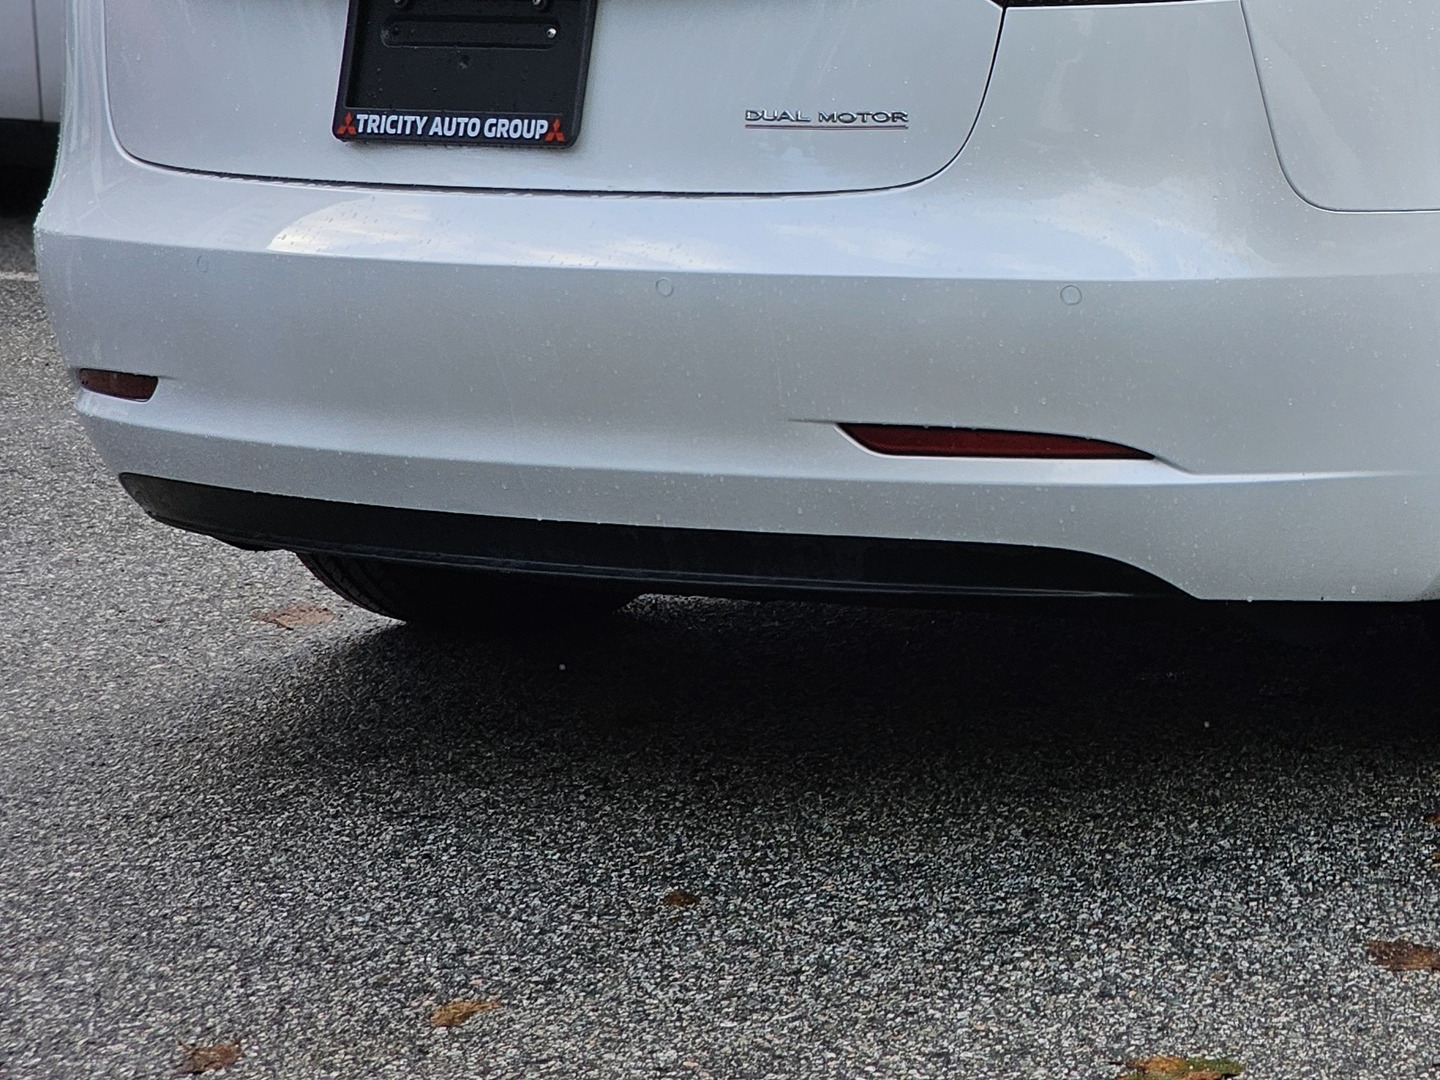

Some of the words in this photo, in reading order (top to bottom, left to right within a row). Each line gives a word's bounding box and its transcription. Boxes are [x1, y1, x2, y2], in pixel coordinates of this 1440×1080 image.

[356, 113, 428, 136] TRICITY
[429, 116, 482, 138] AUTO
[483, 118, 549, 140] GROUP
[745, 109, 811, 123] DUAL
[817, 110, 909, 124] MOTOR
